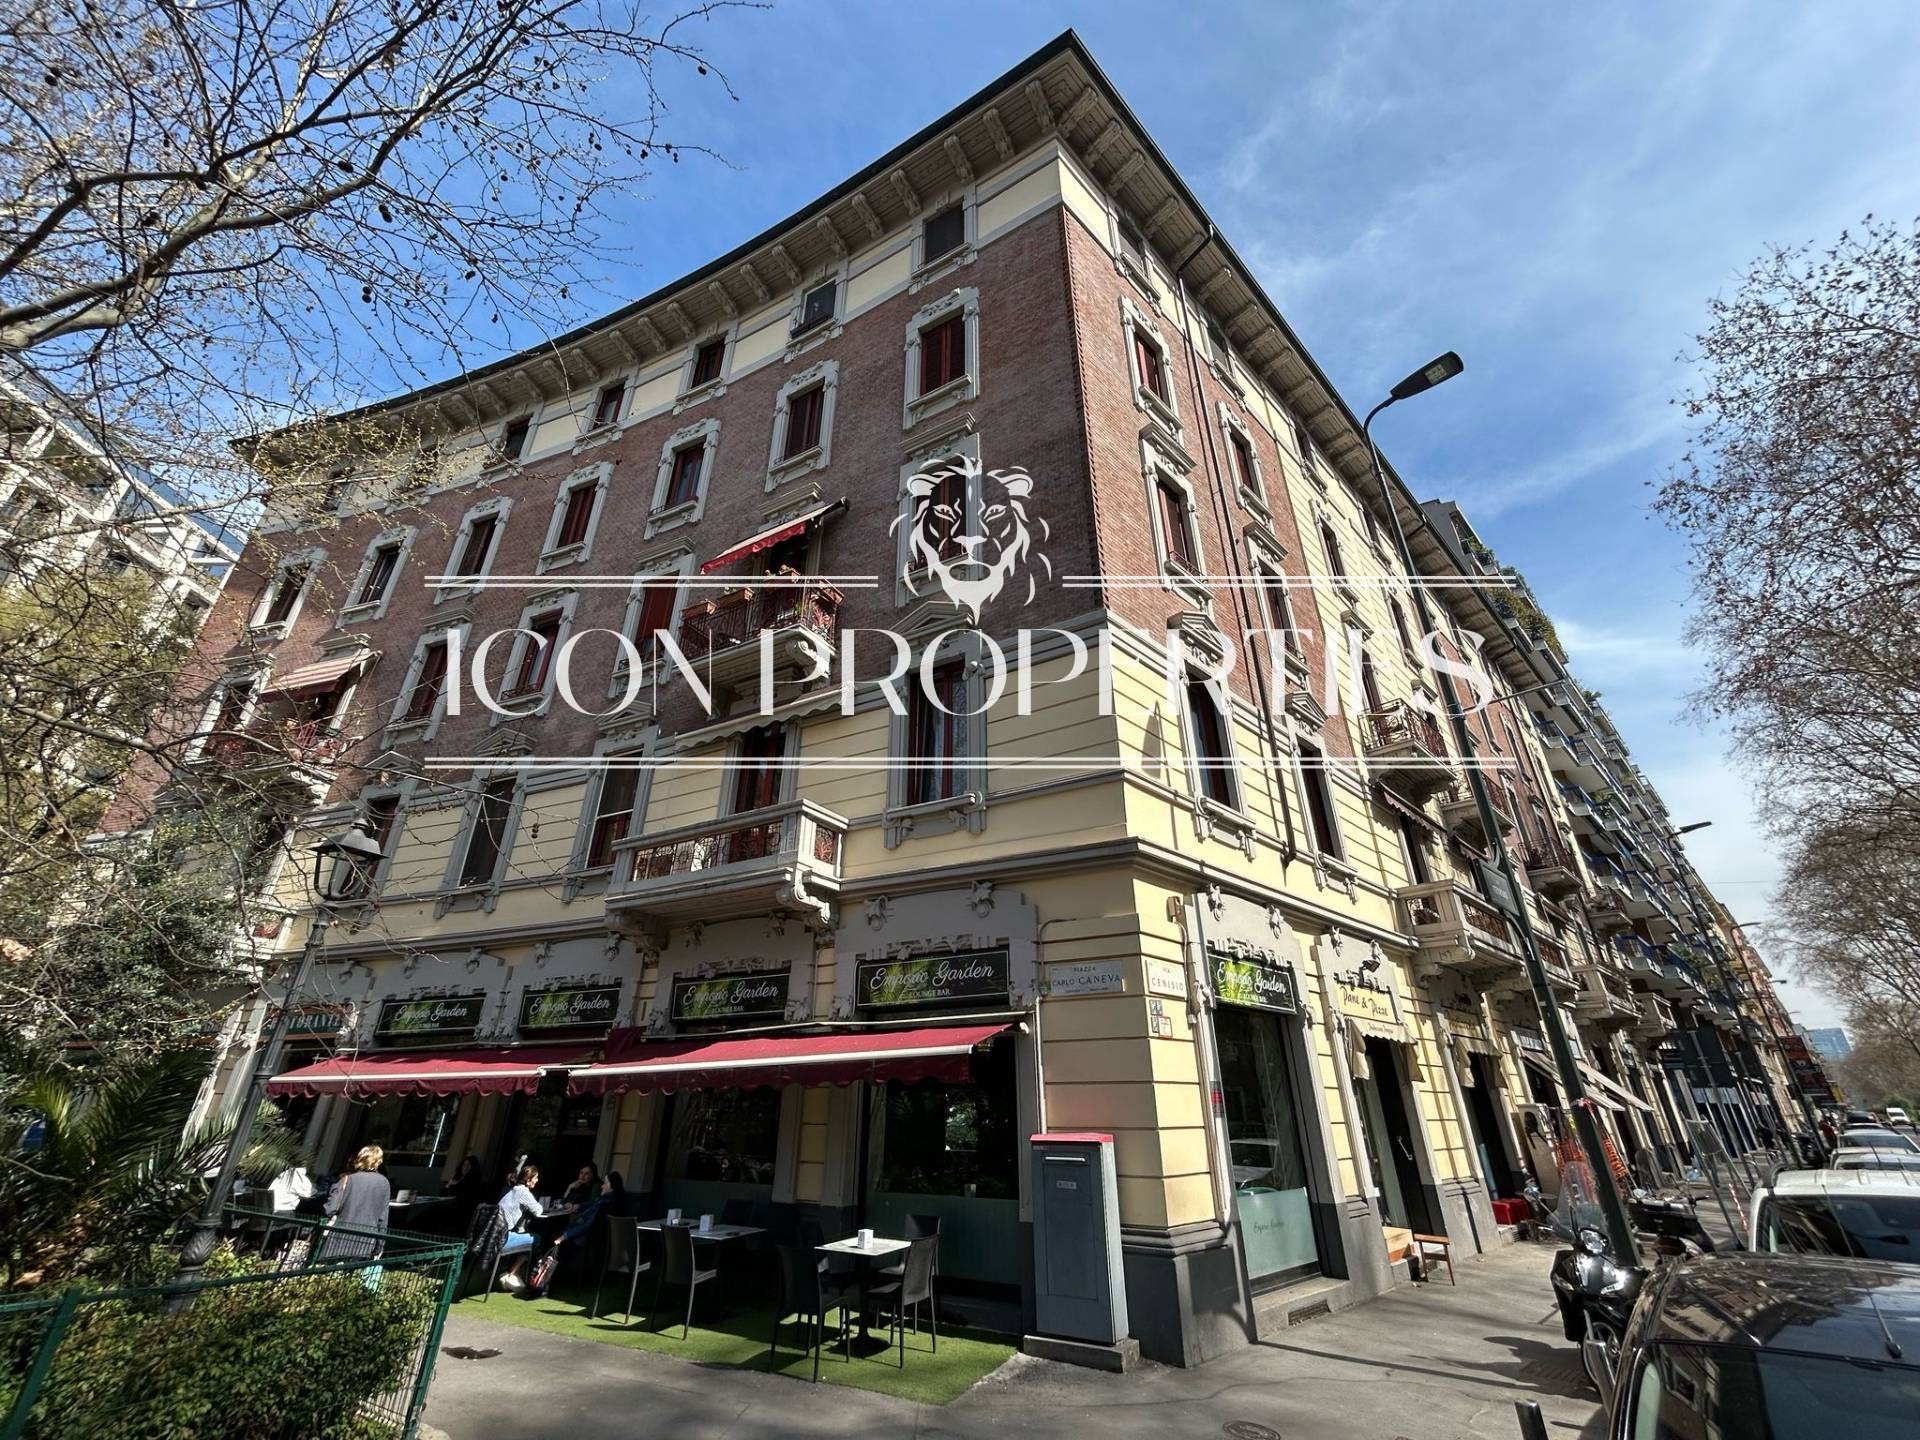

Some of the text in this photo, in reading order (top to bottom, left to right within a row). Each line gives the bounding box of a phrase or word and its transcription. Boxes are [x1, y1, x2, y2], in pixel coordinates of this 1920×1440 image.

[932, 959, 994, 987] Garden
[1051, 973, 1121, 987] CARLO CANEVA
[1073, 965, 1096, 973] PIAZZA
[730, 980, 779, 1004] Garden
[1151, 977, 1184, 991] CENISIO
[1254, 970, 1286, 994] Garden
[569, 993, 611, 1015] Garden
[1339, 985, 1360, 1006] Pane
[1361, 997, 1368, 1009] &
[430, 1001, 469, 1022] Garden
